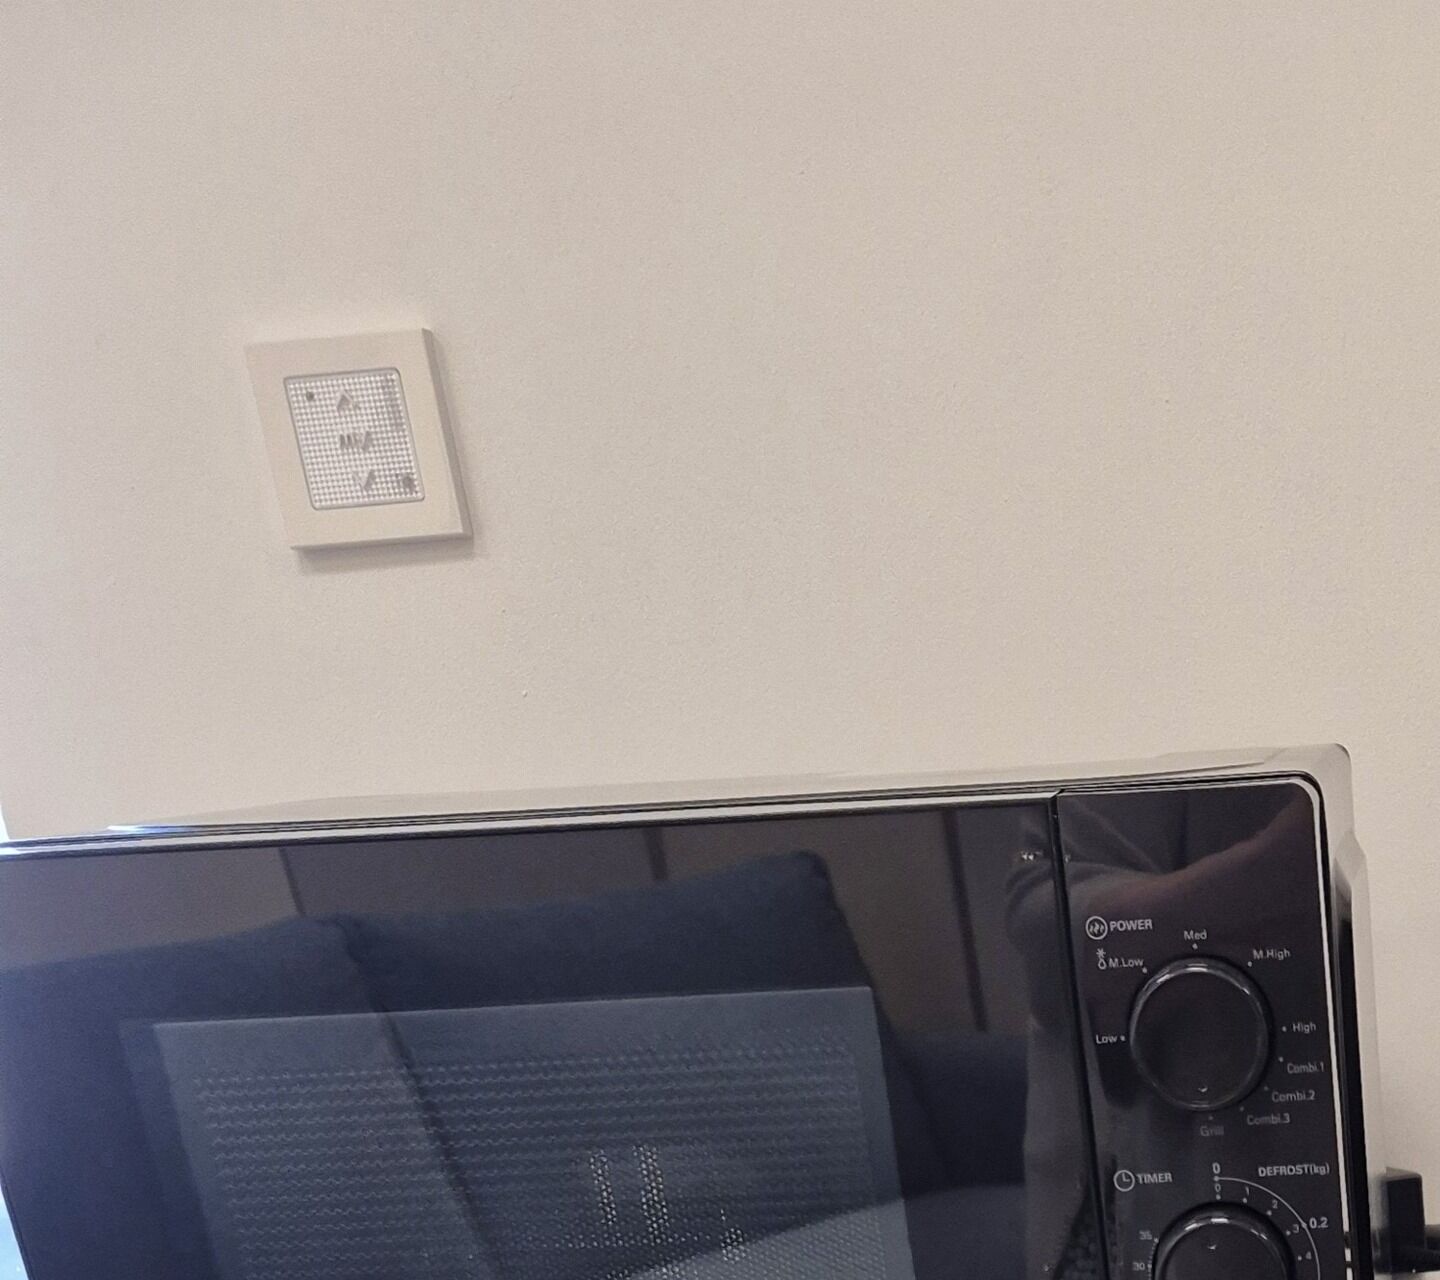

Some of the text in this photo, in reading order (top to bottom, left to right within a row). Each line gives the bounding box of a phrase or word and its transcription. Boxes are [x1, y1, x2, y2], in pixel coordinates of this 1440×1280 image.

[1109, 918, 1153, 932] POWER
[1183, 929, 1208, 941] Med
[1252, 948, 1291, 961] M.High
[1108, 957, 1144, 969] M.Low
[1292, 1021, 1317, 1034] High
[1095, 1034, 1118, 1044] Low
[1287, 1061, 1325, 1074] Combi.1
[1271, 1089, 1316, 1103] Combi.2
[1246, 1112, 1291, 1126] Combi.3
[1211, 1162, 1221, 1175] 0
[1258, 1162, 1330, 1177] DEFROST(kg)
[1136, 1172, 1173, 1185] TIMER
[1214, 1182, 1221, 1193] 0
[1271, 1199, 1279, 1210] 2
[1292, 1223, 1300, 1234] 3
[1309, 1216, 1329, 1230] 0.2
[1305, 1251, 1313, 1261] 4
[1132, 1261, 1146, 1272] 30
